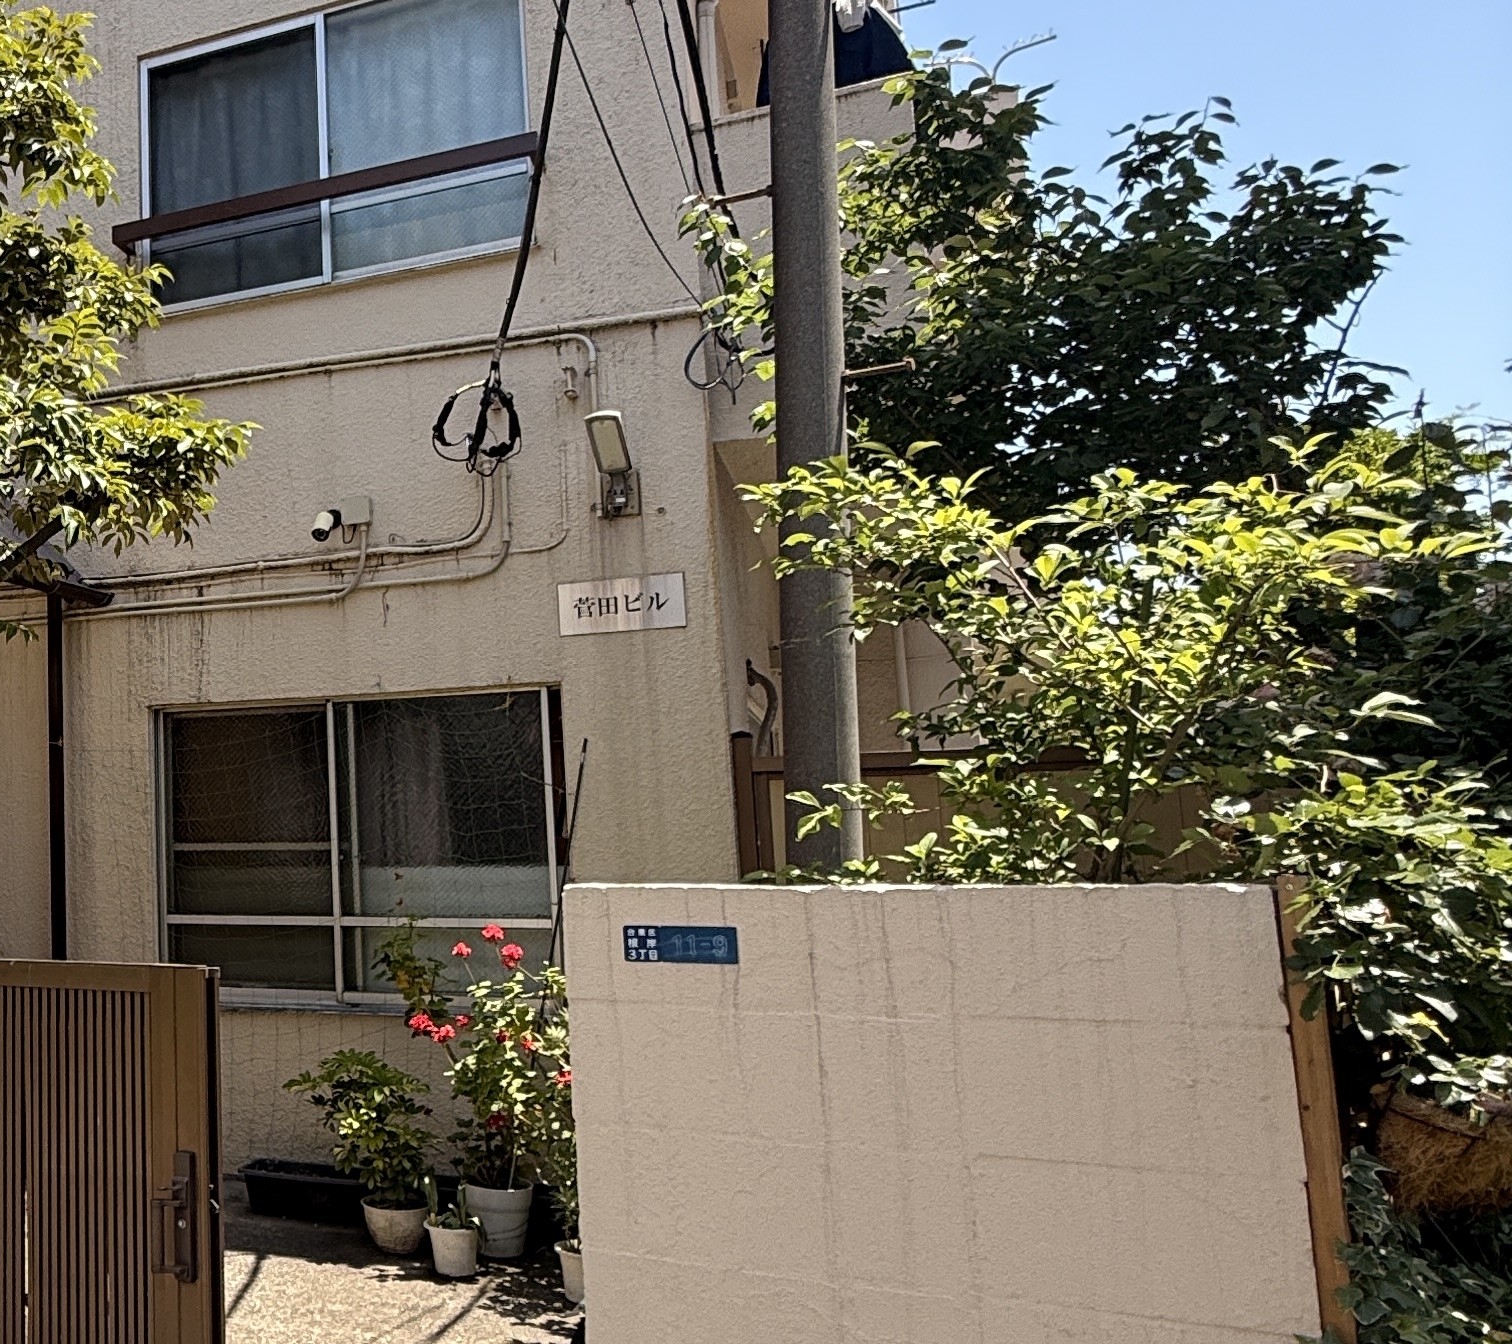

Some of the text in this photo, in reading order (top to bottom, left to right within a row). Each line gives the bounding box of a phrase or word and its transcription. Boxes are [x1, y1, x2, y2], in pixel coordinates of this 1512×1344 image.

[572, 593, 669, 619] 菅田ビル
[628, 949, 658, 960] 3丁目
[670, 934, 728, 957] 11-9
